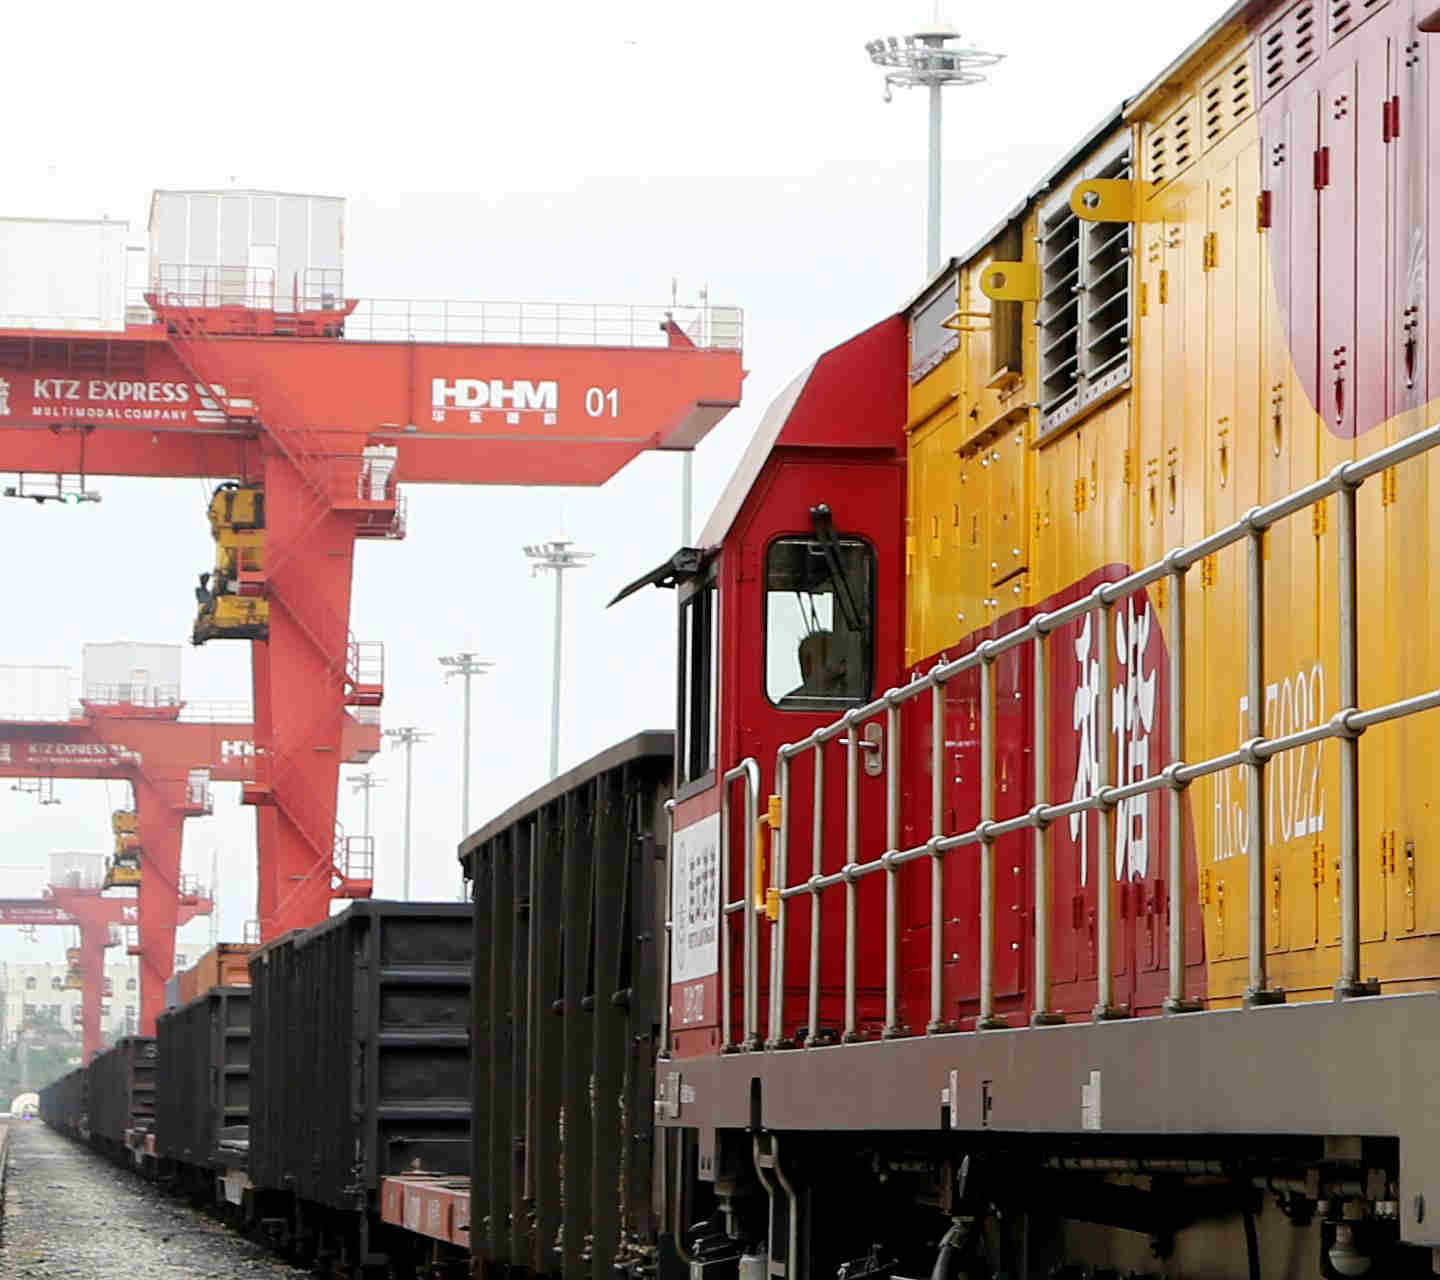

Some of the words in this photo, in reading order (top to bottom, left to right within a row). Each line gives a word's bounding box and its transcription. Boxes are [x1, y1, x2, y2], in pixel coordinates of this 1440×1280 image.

[32, 378, 80, 402] KTZ
[88, 379, 191, 404] EXPRESS
[431, 377, 558, 410] HDHM
[584, 386, 619, 419] 01
